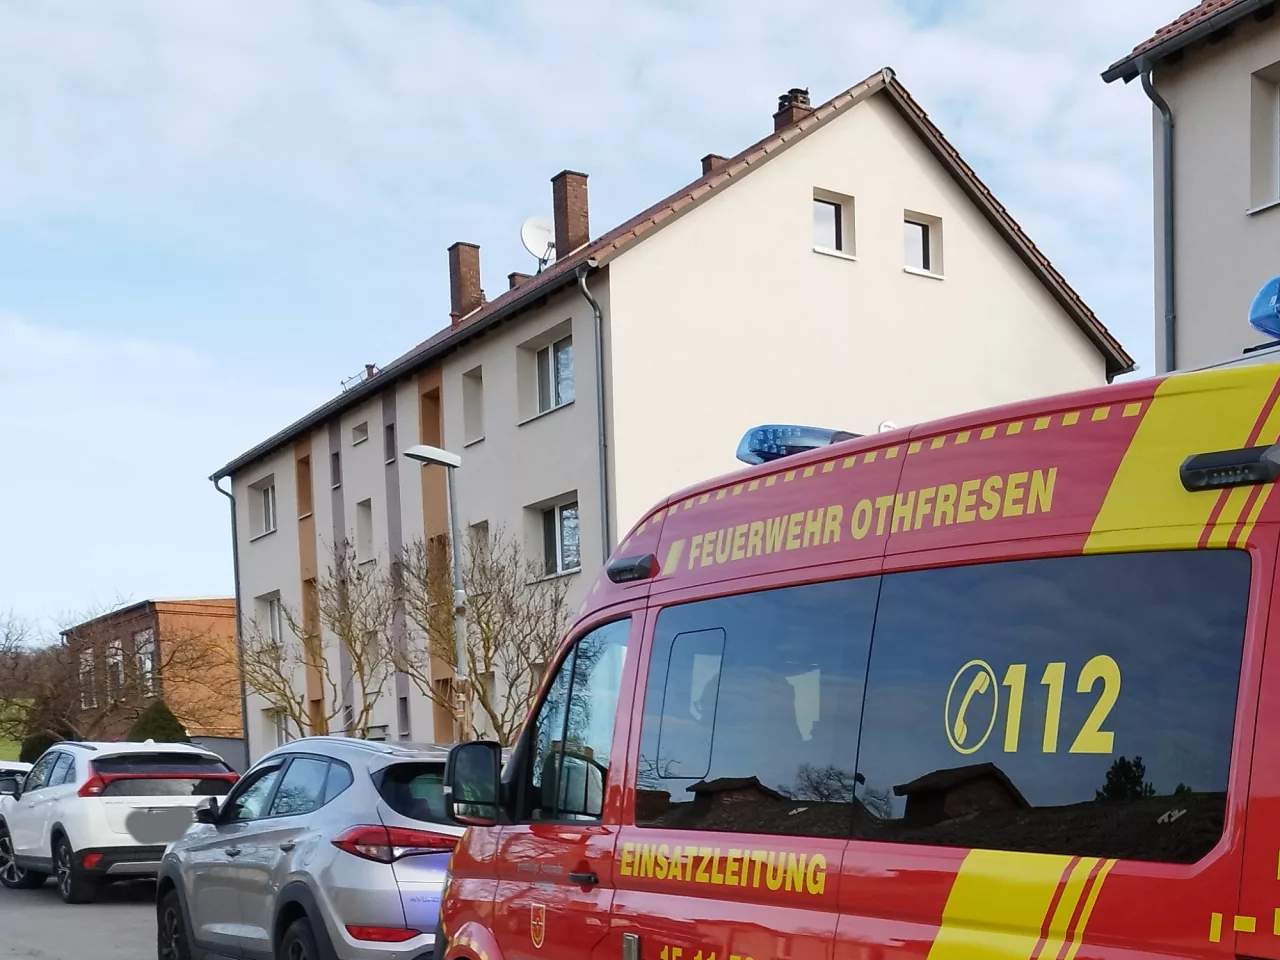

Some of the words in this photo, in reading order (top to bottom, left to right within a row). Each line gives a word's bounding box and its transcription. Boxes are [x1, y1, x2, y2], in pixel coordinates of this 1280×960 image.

[689, 504, 842, 570] FEUERWEHR
[851, 467, 1058, 538] OTHFRESEN
[1002, 655, 1121, 754] 112
[620, 842, 826, 895] EINSATZLEITUNG
